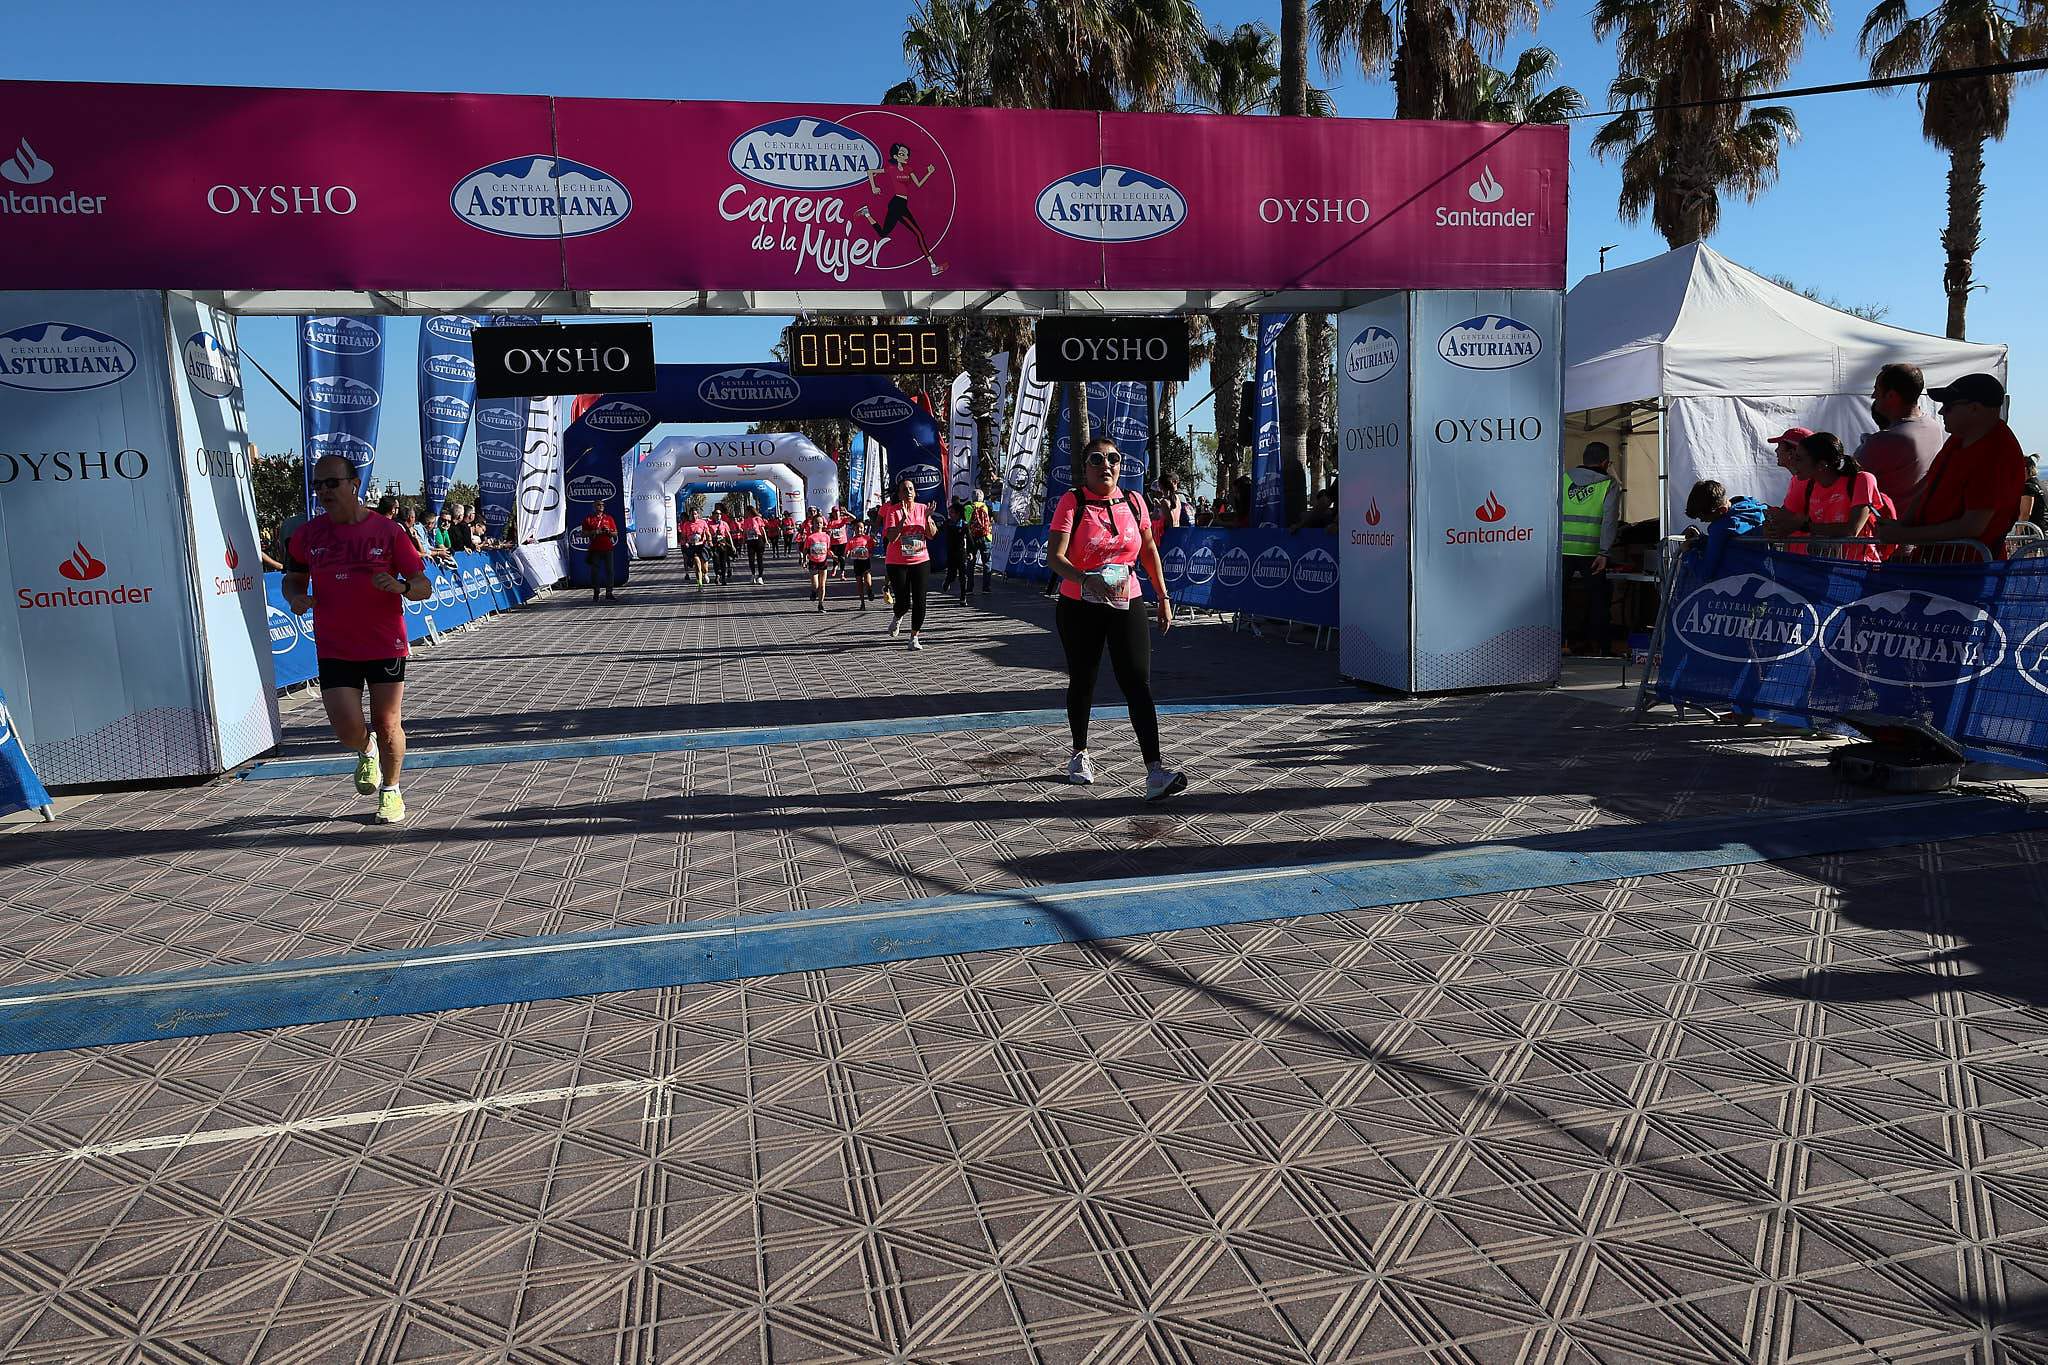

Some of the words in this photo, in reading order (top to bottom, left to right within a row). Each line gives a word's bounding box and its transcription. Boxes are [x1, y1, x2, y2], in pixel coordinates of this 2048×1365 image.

[741, 143, 870, 172] ASTURIANA
[763, 141, 812, 150] CENTRAL
[817, 142, 865, 151] LECHERA
[207, 184, 357, 215] OYSHO
[492, 184, 549, 192] CENTRAL
[1071, 191, 1117, 200] CENTRAL
[1122, 192, 1171, 200] LECHERA
[466, 185, 619, 217] ASTURIANA
[718, 183, 846, 224] Carrera
[1048, 193, 1177, 222] ASTURIANA
[1258, 198, 1370, 224] OYSHO
[1435, 206, 1536, 227] Santander
[751, 225, 776, 251] de
[780, 224, 797, 251] la
[794, 220, 892, 282] Mujer
[306, 327, 375, 347] ASTURIANA
[801, 333, 937, 366] 00:58:36
[1061, 337, 1168, 361] OYSHO
[1445, 335, 1534, 357] ASTURIANA
[428, 361, 476, 378] ASTURIAN
[504, 347, 630, 375] OYSHO
[1348, 348, 1395, 374] ASTURIANA
[706, 382, 794, 401] ASTURIANA
[590, 412, 646, 425] ASTURIANA
[856, 407, 911, 420] ASTURIANA
[1346, 422, 1399, 452] OYSHO
[1434, 416, 1542, 443] OYSHO
[521, 396, 560, 515] OYSH
[694, 440, 776, 458] OYSHO
[0, 449, 149, 484] OYSHO
[197, 447, 246, 479] OYSHO
[568, 486, 613, 497] ASTURIANA
[1351, 529, 1395, 547] Santander
[1446, 525, 1534, 545] Santander
[18, 584, 153, 609] Santander
[215, 572, 254, 596] Santander
[1681, 601, 1803, 645] ASTURIANA
[1829, 616, 1986, 666] ASTURIANA
